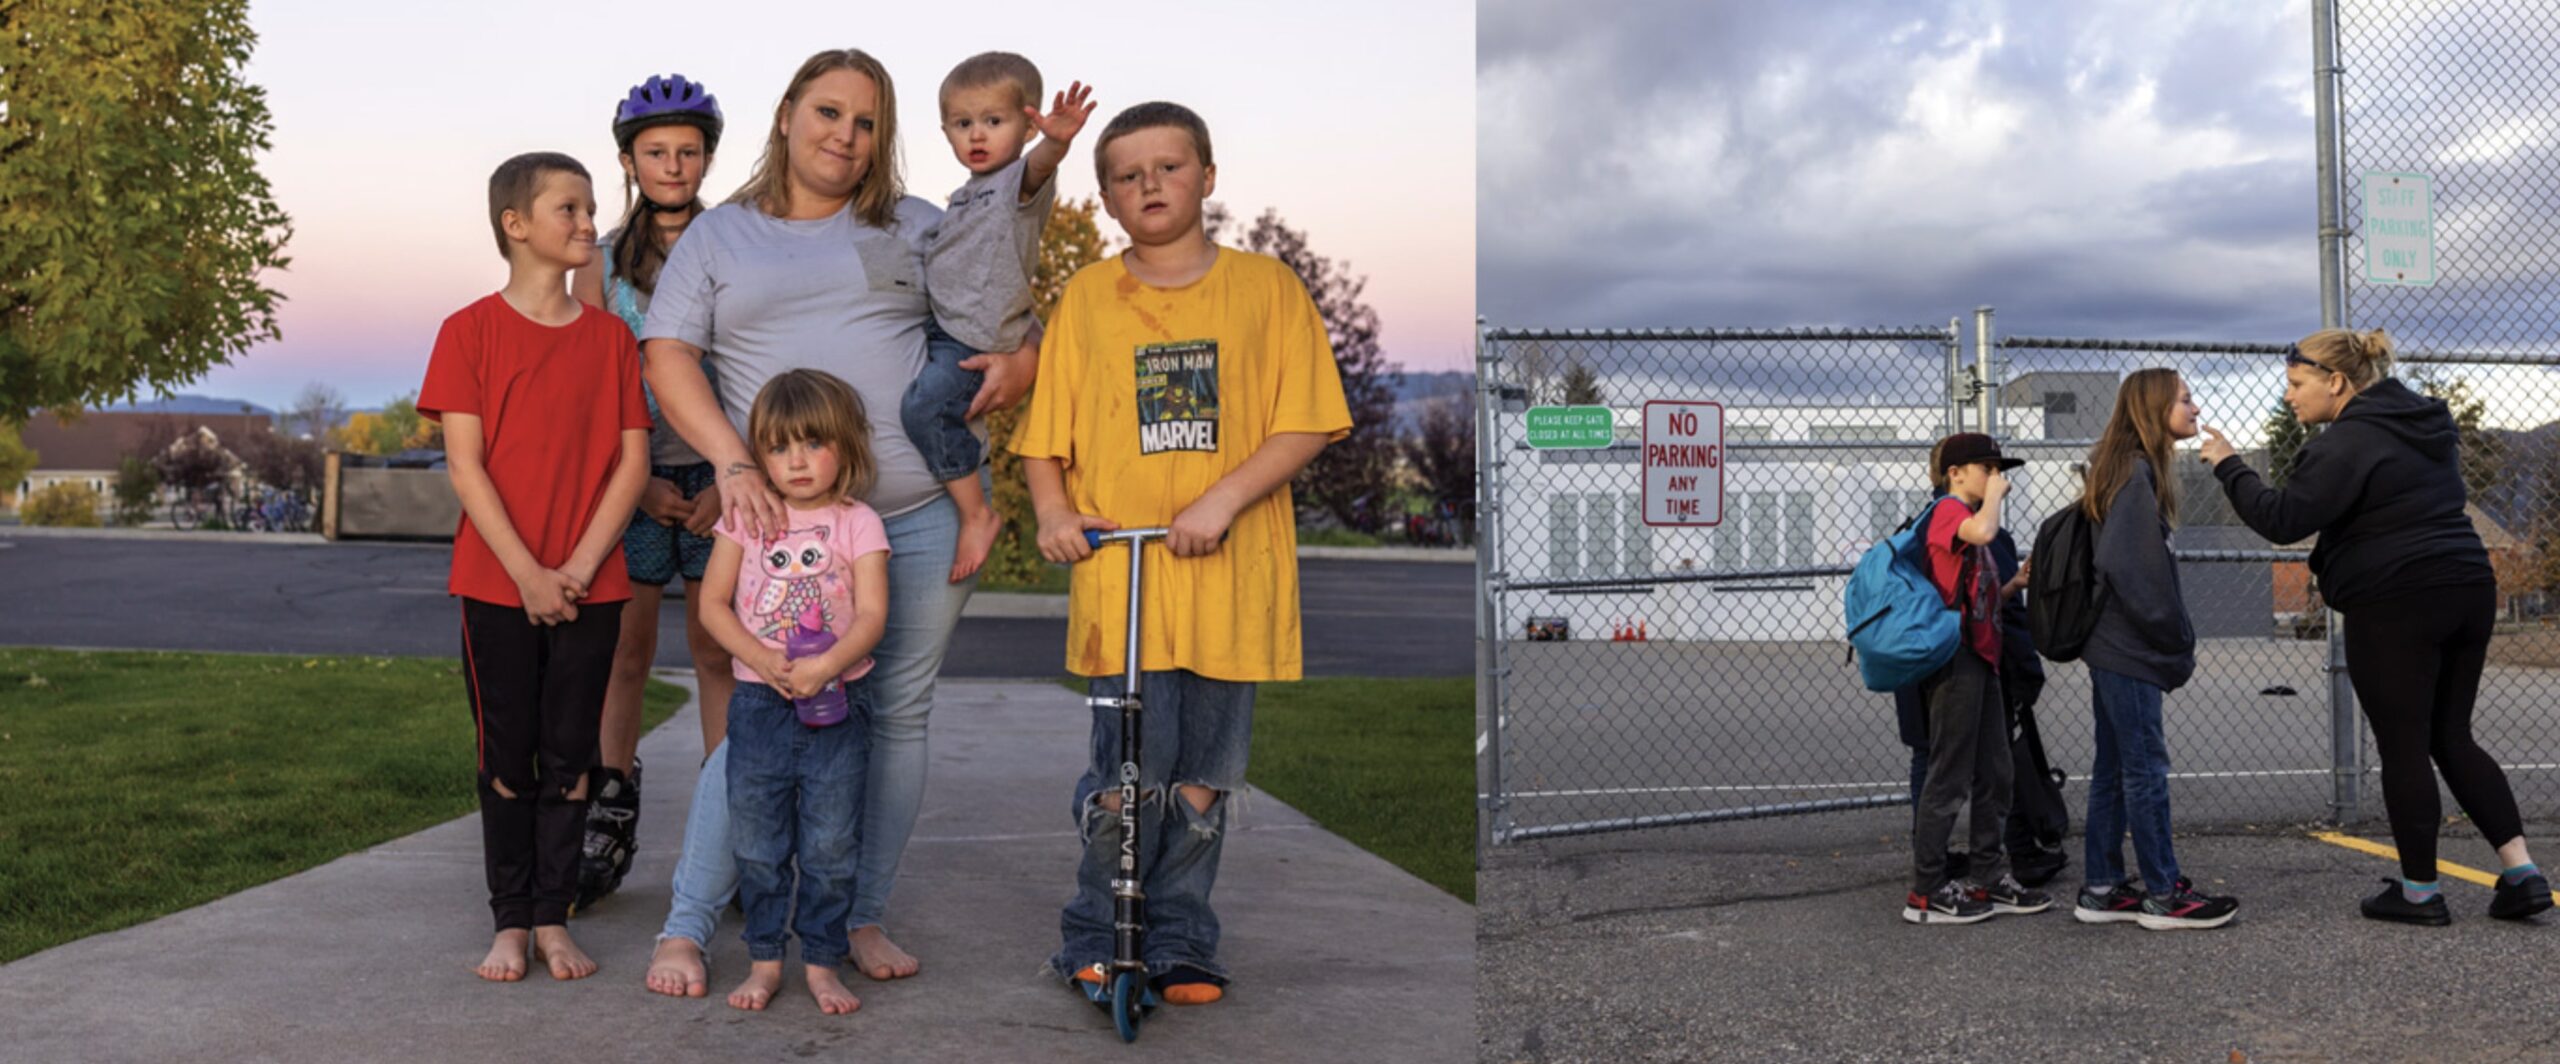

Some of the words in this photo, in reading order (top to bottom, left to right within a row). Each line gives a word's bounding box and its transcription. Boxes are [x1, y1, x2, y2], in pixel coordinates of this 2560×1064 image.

[2370, 217, 2428, 239] PARKING
[2383, 249, 2417, 269] ONLY
[1145, 354, 1180, 374] IRON
[1182, 351, 1215, 371] MAN
[1533, 415, 1562, 426] PLEASE
[1564, 415, 1583, 426] KEEP
[1586, 414, 1605, 425] GATE
[1668, 413, 1698, 436] NO
[1141, 420, 1216, 453] MARVEL
[1529, 430, 1558, 440] CLOSED
[1560, 430, 1570, 440] AT
[1572, 430, 1586, 440] ALL
[1588, 429, 1611, 440] TIMES
[1649, 444, 1717, 468] PARKING
[1668, 476, 1698, 491] ANY
[1666, 500, 1700, 515] TIME
